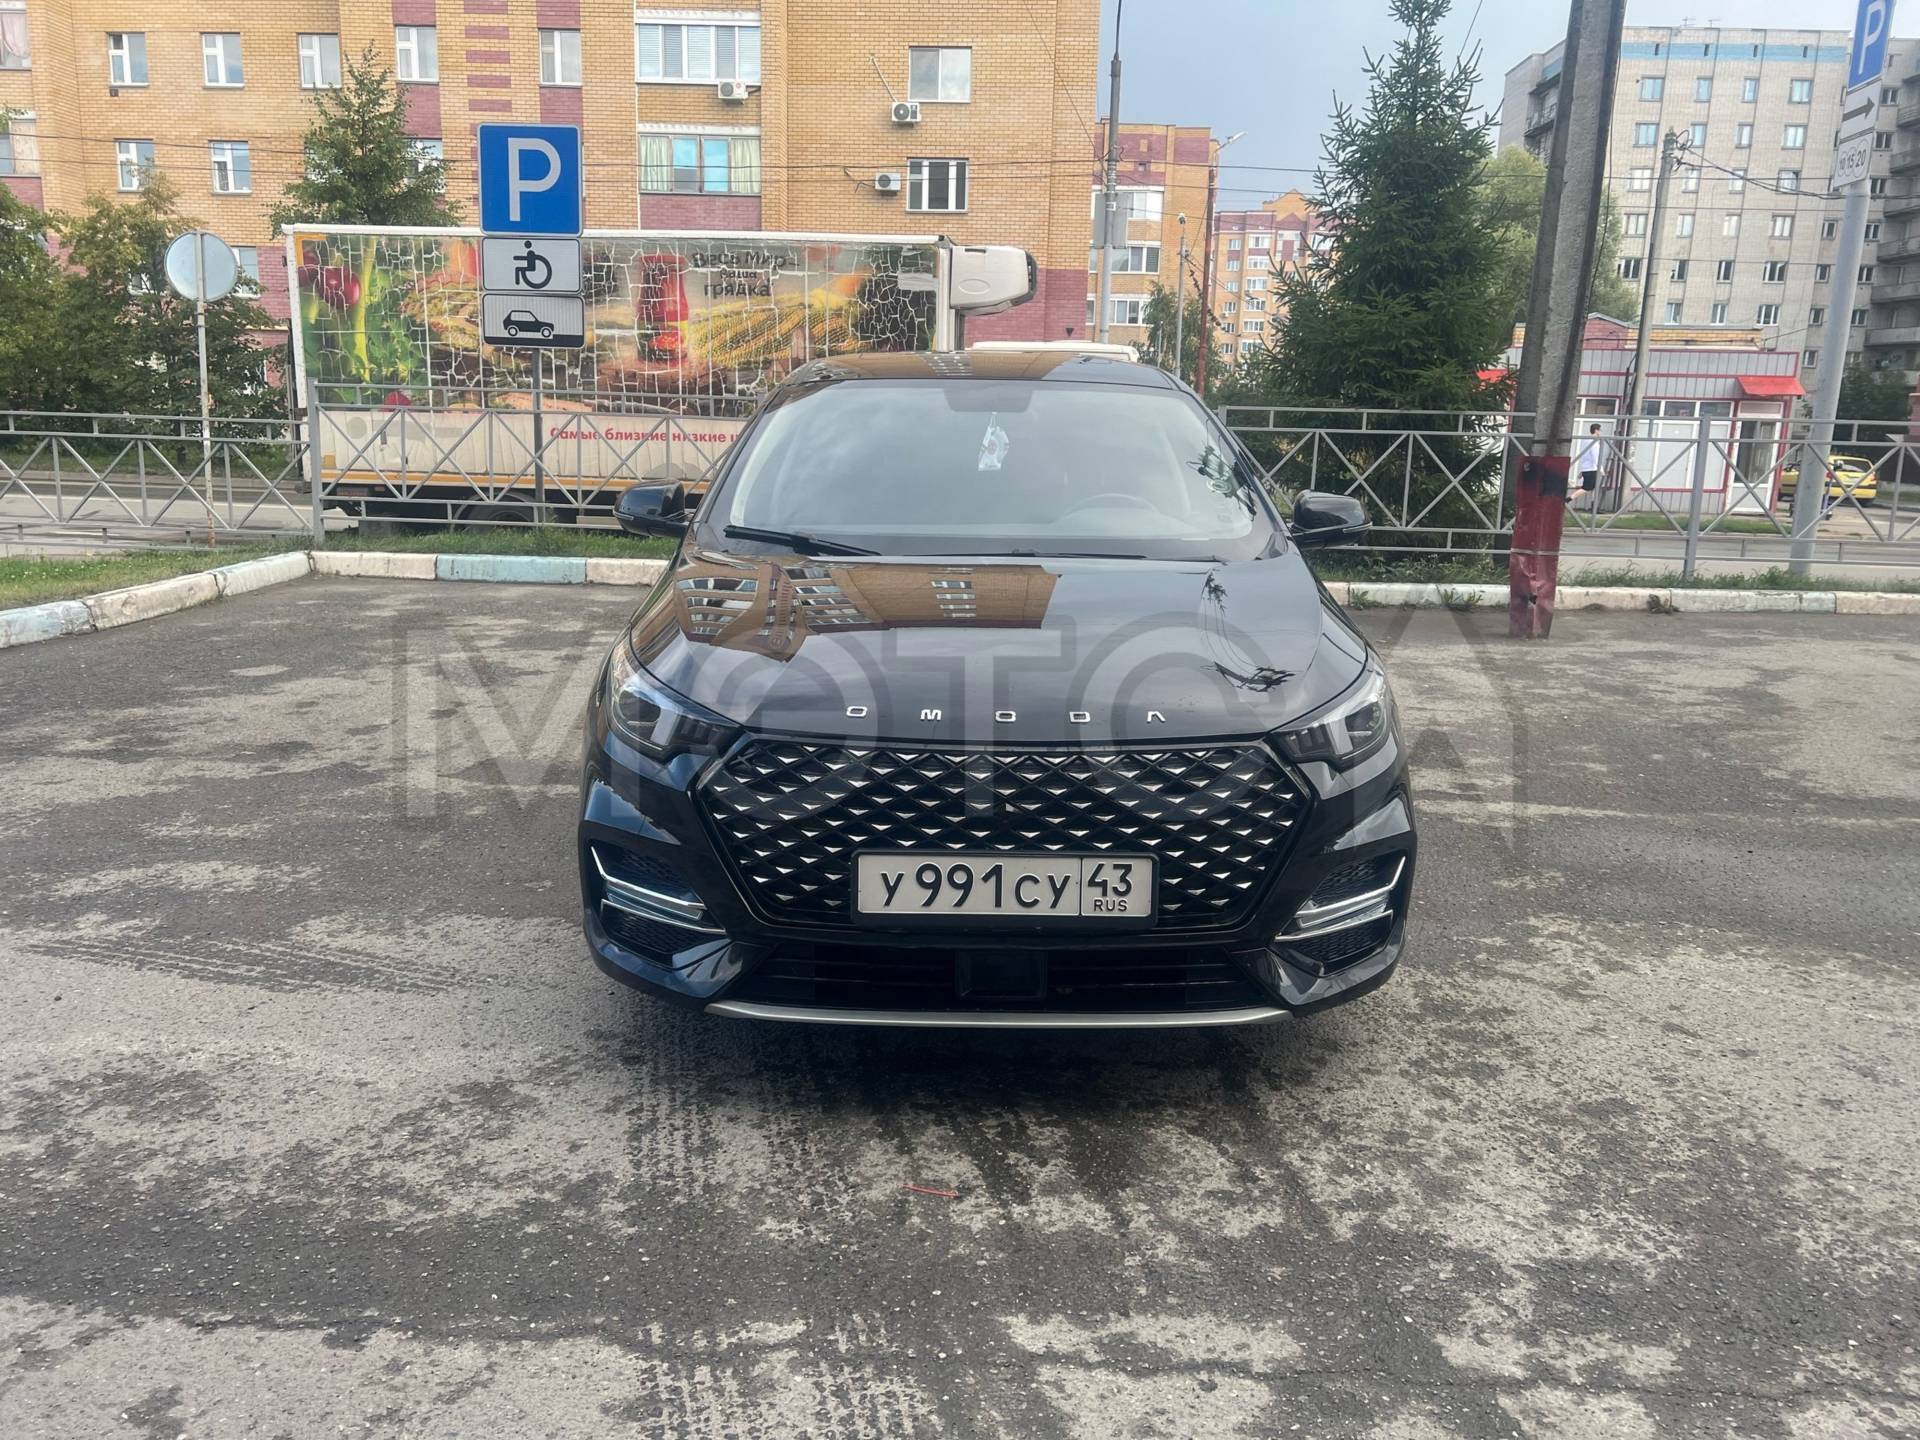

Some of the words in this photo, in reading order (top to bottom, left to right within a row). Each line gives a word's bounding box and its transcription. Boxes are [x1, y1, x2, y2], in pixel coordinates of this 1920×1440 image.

[1858, 0, 1886, 75] P
[1855, 149, 1867, 168] 20
[508, 137, 562, 222] P
[550, 427, 599, 440] Самые
[605, 428, 667, 441] близкие
[1087, 863, 1133, 897] 43
[1093, 899, 1128, 912] RUS
